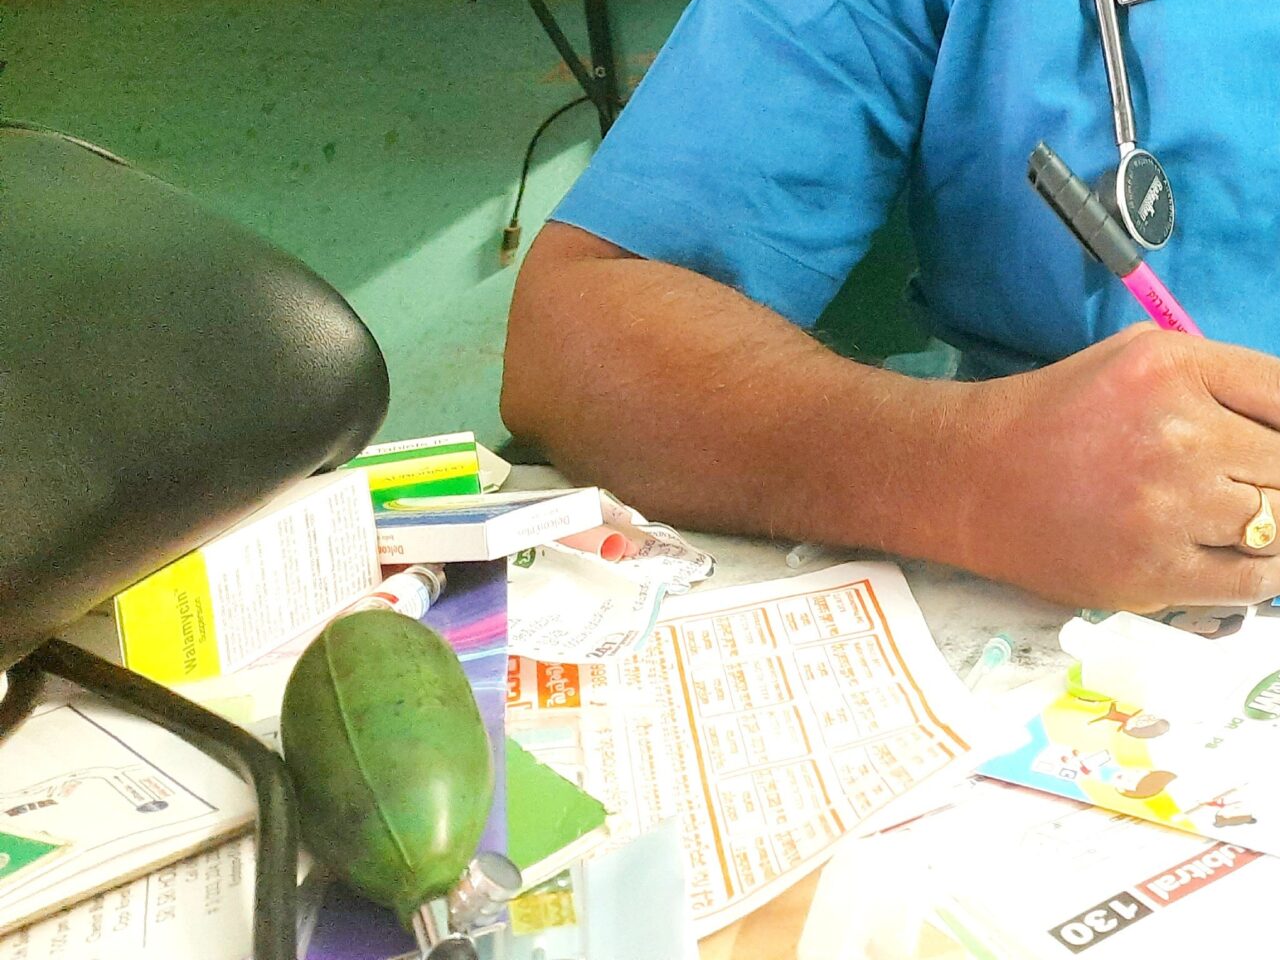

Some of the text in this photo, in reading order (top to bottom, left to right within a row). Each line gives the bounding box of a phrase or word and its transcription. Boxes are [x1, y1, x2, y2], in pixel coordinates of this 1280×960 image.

[1146, 287, 1163, 308] Ltd.
[1162, 306, 1178, 327] Pvt.
[177, 591, 198, 674] Walamycin
[1062, 895, 1141, 944] 130
